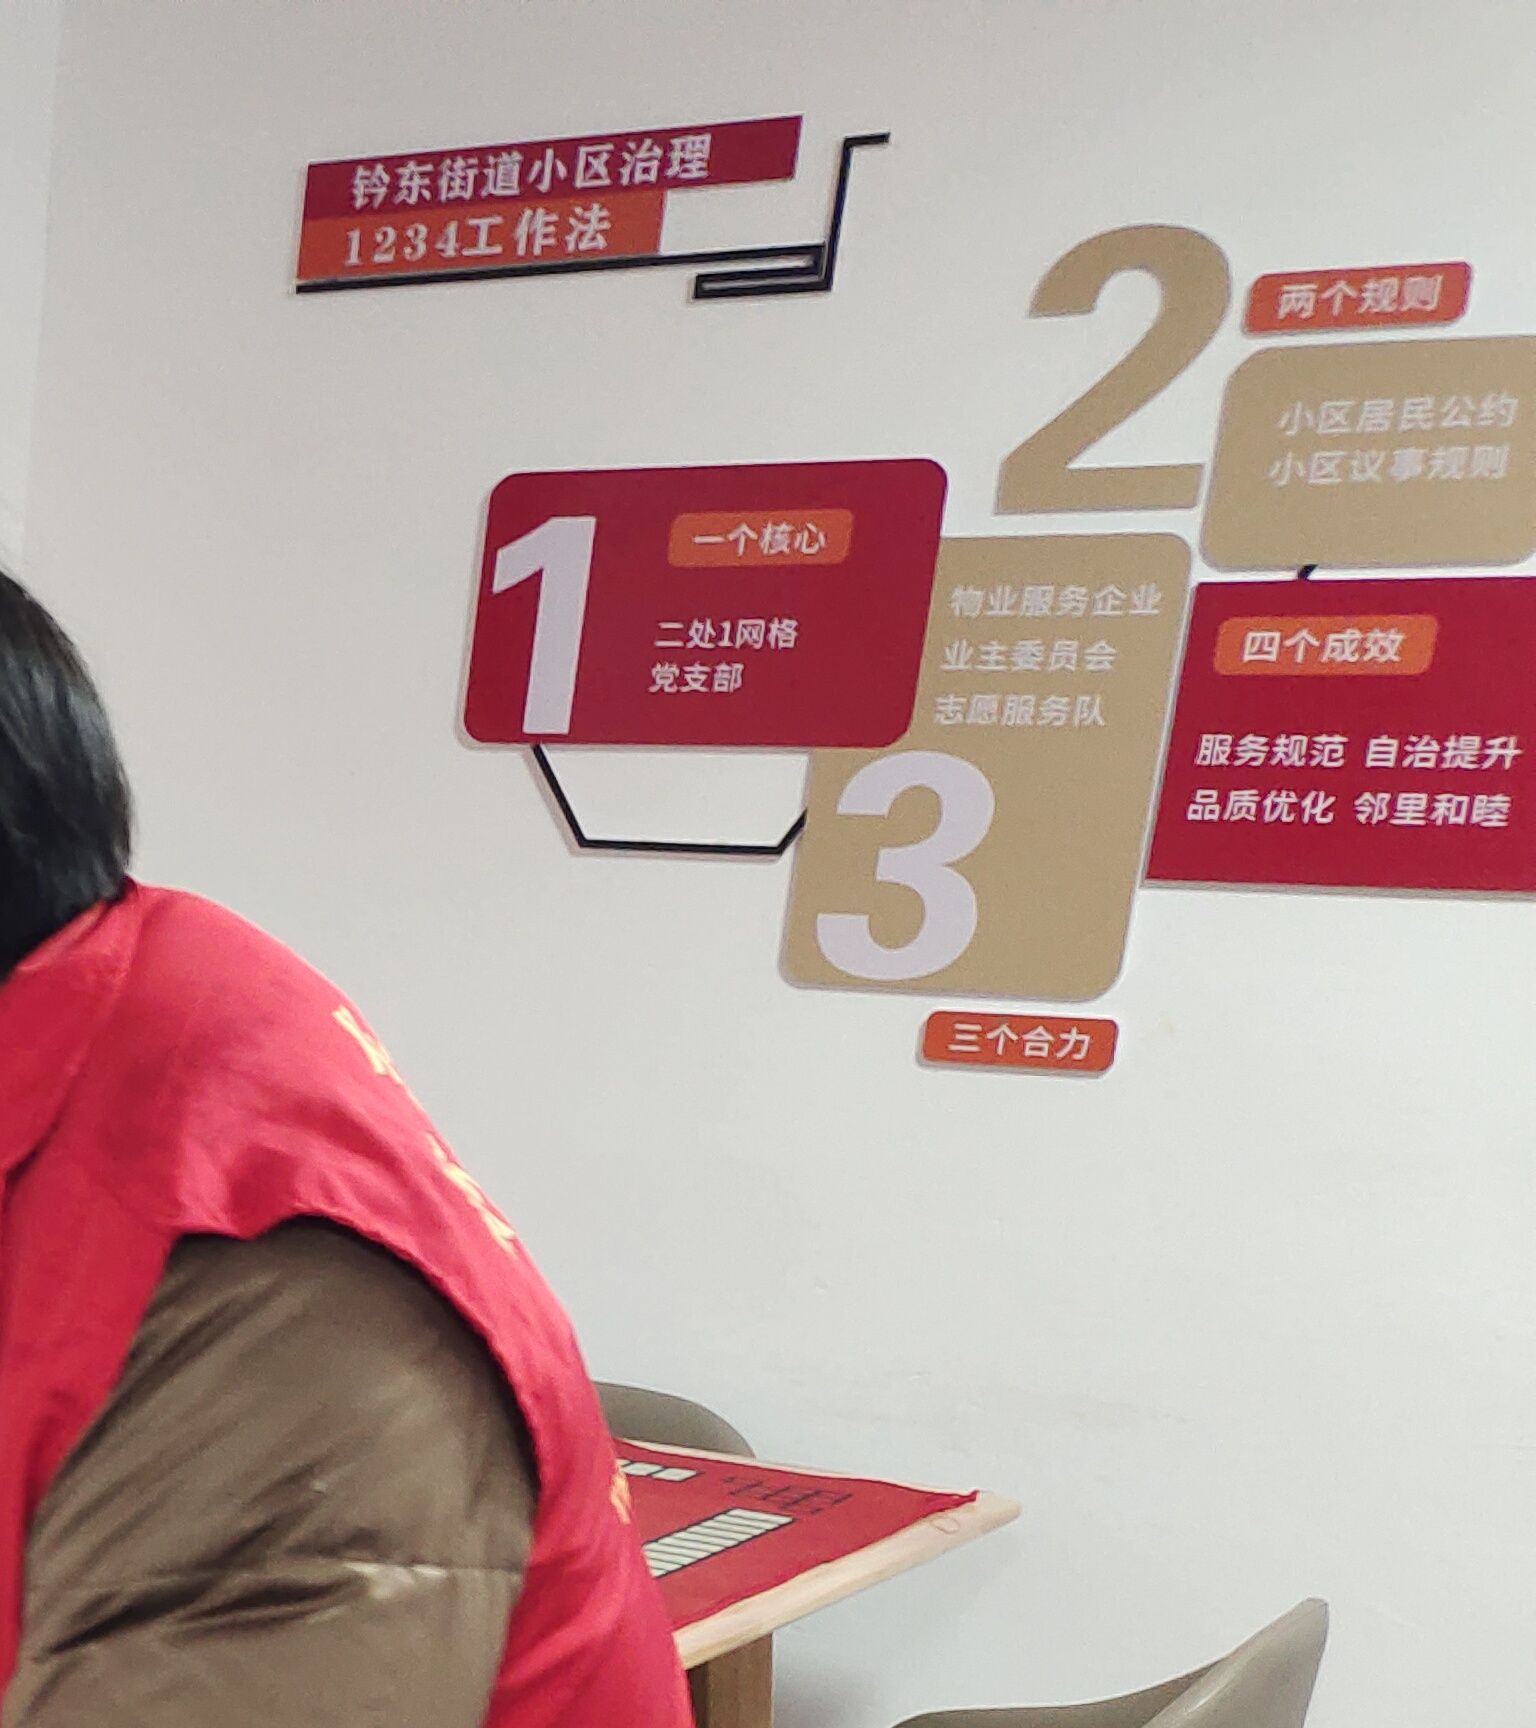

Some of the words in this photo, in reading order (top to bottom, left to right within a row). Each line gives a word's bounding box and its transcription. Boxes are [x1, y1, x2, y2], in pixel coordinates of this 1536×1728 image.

[345, 205, 612, 267] 1234工作法
[1277, 274, 1441, 320] 两个规则
[995, 224, 1231, 514] 2
[1278, 394, 1519, 436] 小区居民公约
[1268, 445, 1510, 486] 小区议事规则
[692, 520, 826, 558] 一个核心
[950, 584, 1161, 619] 物业服务企业
[492, 516, 597, 735] 1
[941, 640, 1118, 674] 业主委员会
[1242, 629, 1401, 664] 四个成效
[649, 662, 744, 694] 党支部
[933, 694, 1106, 728] 志愿服务队
[1194, 734, 1346, 768] 服务规范
[1364, 734, 1522, 770] 自治提升
[1186, 791, 1335, 825] 品质优化
[1354, 792, 1510, 828] 邻里和睦
[816, 749, 995, 982] 3
[948, 1022, 1090, 1061] 三个合力
